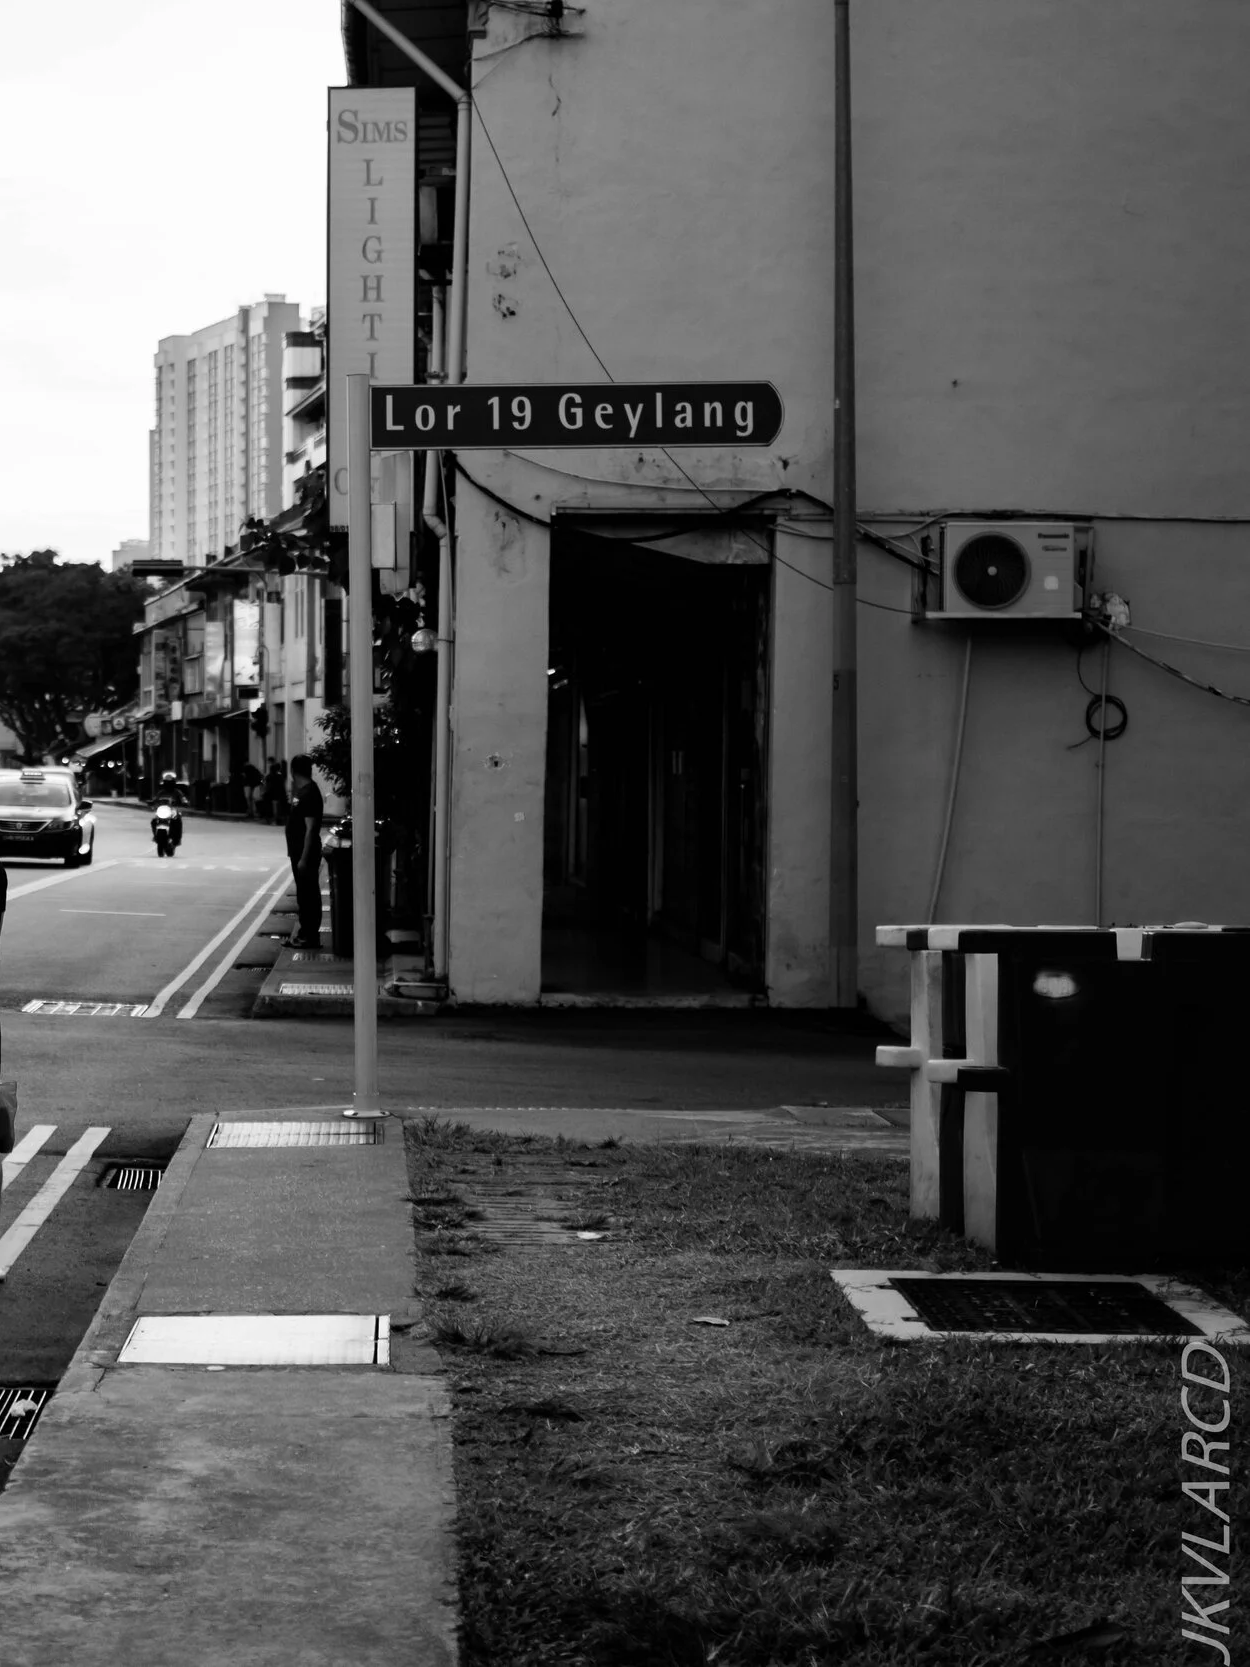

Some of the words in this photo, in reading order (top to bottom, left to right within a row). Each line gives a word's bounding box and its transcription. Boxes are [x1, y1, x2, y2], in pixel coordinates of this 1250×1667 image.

[359, 158, 385, 380] LIGHTI
[385, 394, 461, 431] Lor
[487, 396, 532, 430] 19
[558, 391, 754, 439] Geylang
